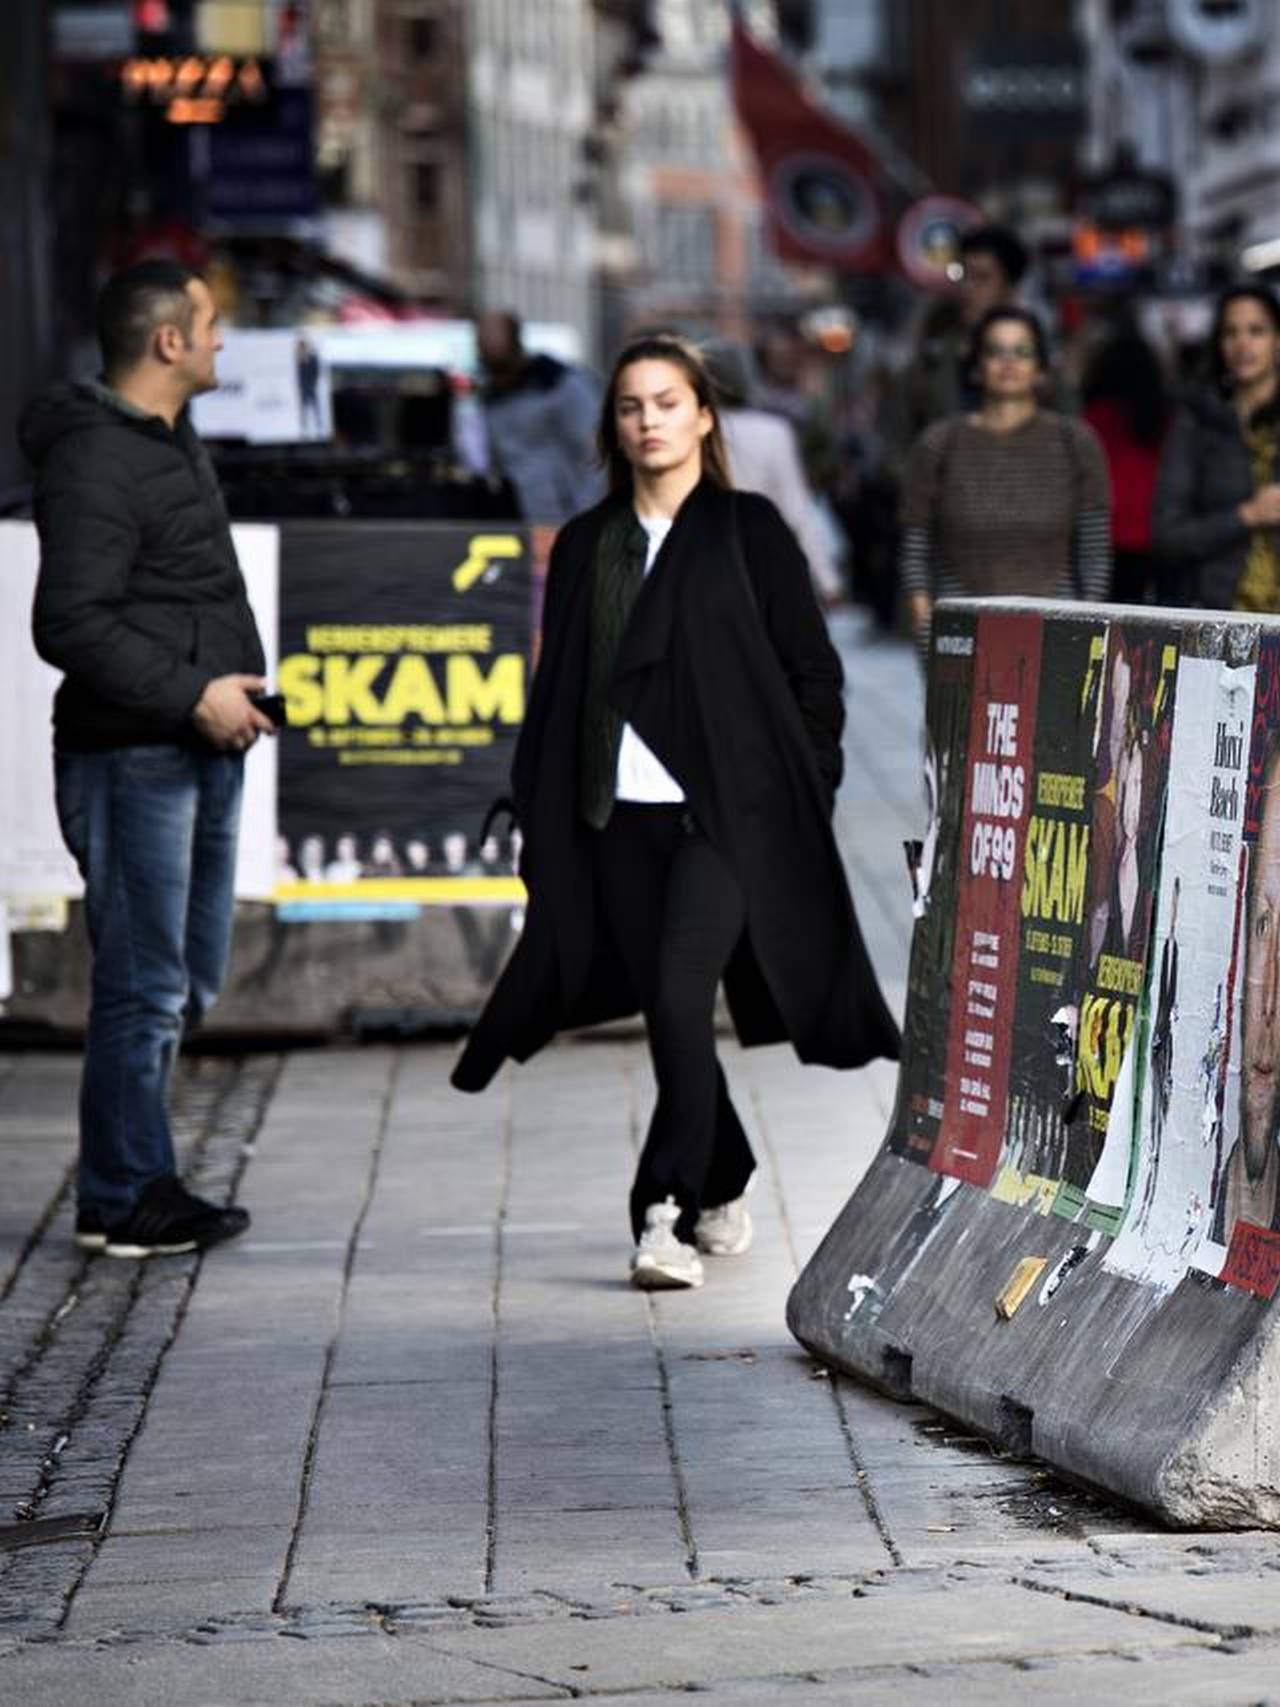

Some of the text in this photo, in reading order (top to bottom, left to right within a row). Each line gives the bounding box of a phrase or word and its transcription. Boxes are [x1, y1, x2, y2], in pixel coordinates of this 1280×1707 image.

[278, 654, 525, 726] SKAM
[987, 703, 1019, 757] THE
[971, 762, 1025, 820] MINDS
[1021, 815, 1089, 925] SKAM
